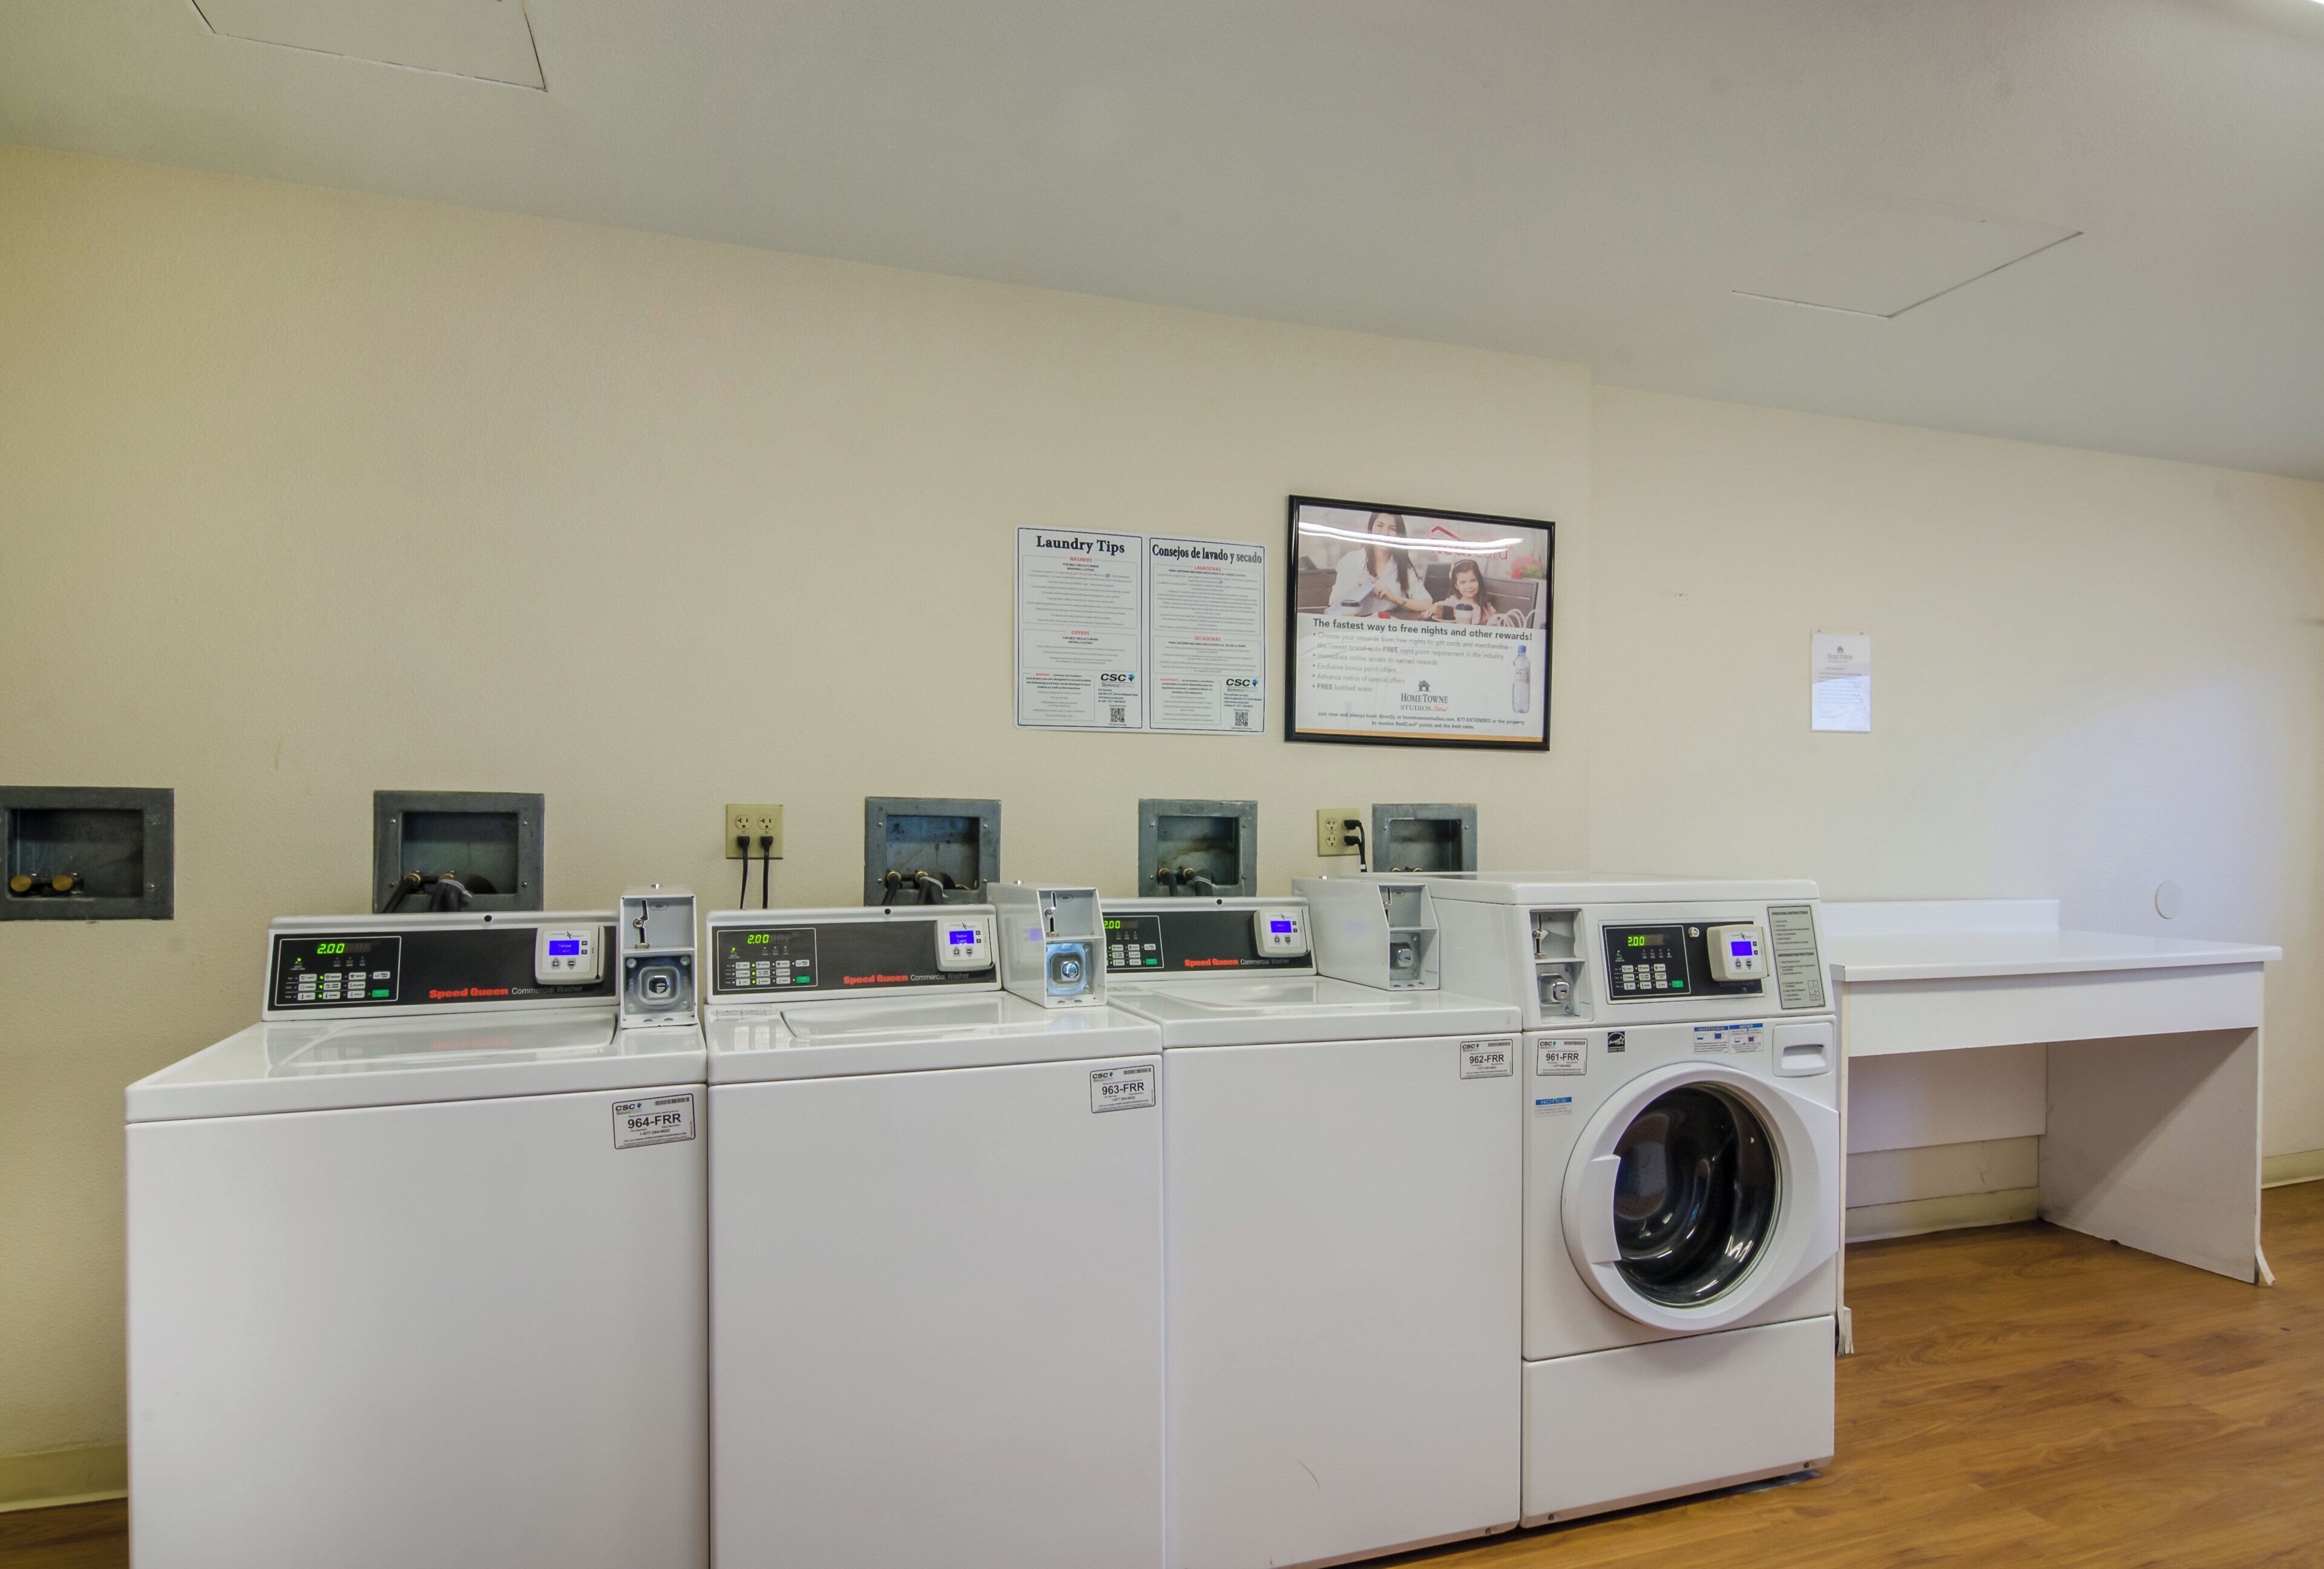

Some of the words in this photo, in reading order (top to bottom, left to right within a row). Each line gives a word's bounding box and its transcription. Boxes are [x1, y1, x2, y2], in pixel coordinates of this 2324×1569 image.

[1036, 536, 1093, 554] Laundry
[1097, 539, 1124, 556] Tips
[1152, 544, 1189, 561] Consejos
[1191, 547, 1200, 558] de
[1202, 547, 1228, 561] lavado
[1230, 553, 1235, 564] y
[1236, 551, 1262, 564] secado
[1313, 618, 1330, 628] The
[1333, 619, 1364, 630] fastest
[1367, 623, 1385, 633] way
[1400, 624, 1419, 634] free
[1421, 625, 1448, 637] nights
[1450, 627, 1466, 636] and
[1469, 629, 1492, 639] other
[1495, 631, 1532, 641] rewards!
[1356, 635, 1380, 643] rewards
[1431, 650, 1464, 659] requirement
[1483, 653, 1503, 661] industry
[1100, 673, 1126, 682] CSC
[1226, 679, 1250, 687] CSC
[1103, 921, 1120, 929] 2.00
[747, 934, 770, 944] 2.00
[1628, 936, 1645, 947] 2.00
[317, 943, 345, 954] 2.00
[1184, 959, 1212, 968] Speed
[843, 975, 875, 986] Speed
[876, 975, 908, 984] Queen
[910, 973, 945, 982] Commercial
[946, 972, 970, 981] Washer
[430, 988, 468, 1000] Speed
[470, 987, 509, 996] Queen
[512, 986, 555, 996] Commercial
[556, 985, 583, 993] Washer
[1469, 1054, 1505, 1064] 962-FRR
[1546, 1053, 1579, 1061] 961-FRR
[1102, 1082, 1144, 1095] 963-FRR
[628, 1113, 681, 1129] 964-FRR
